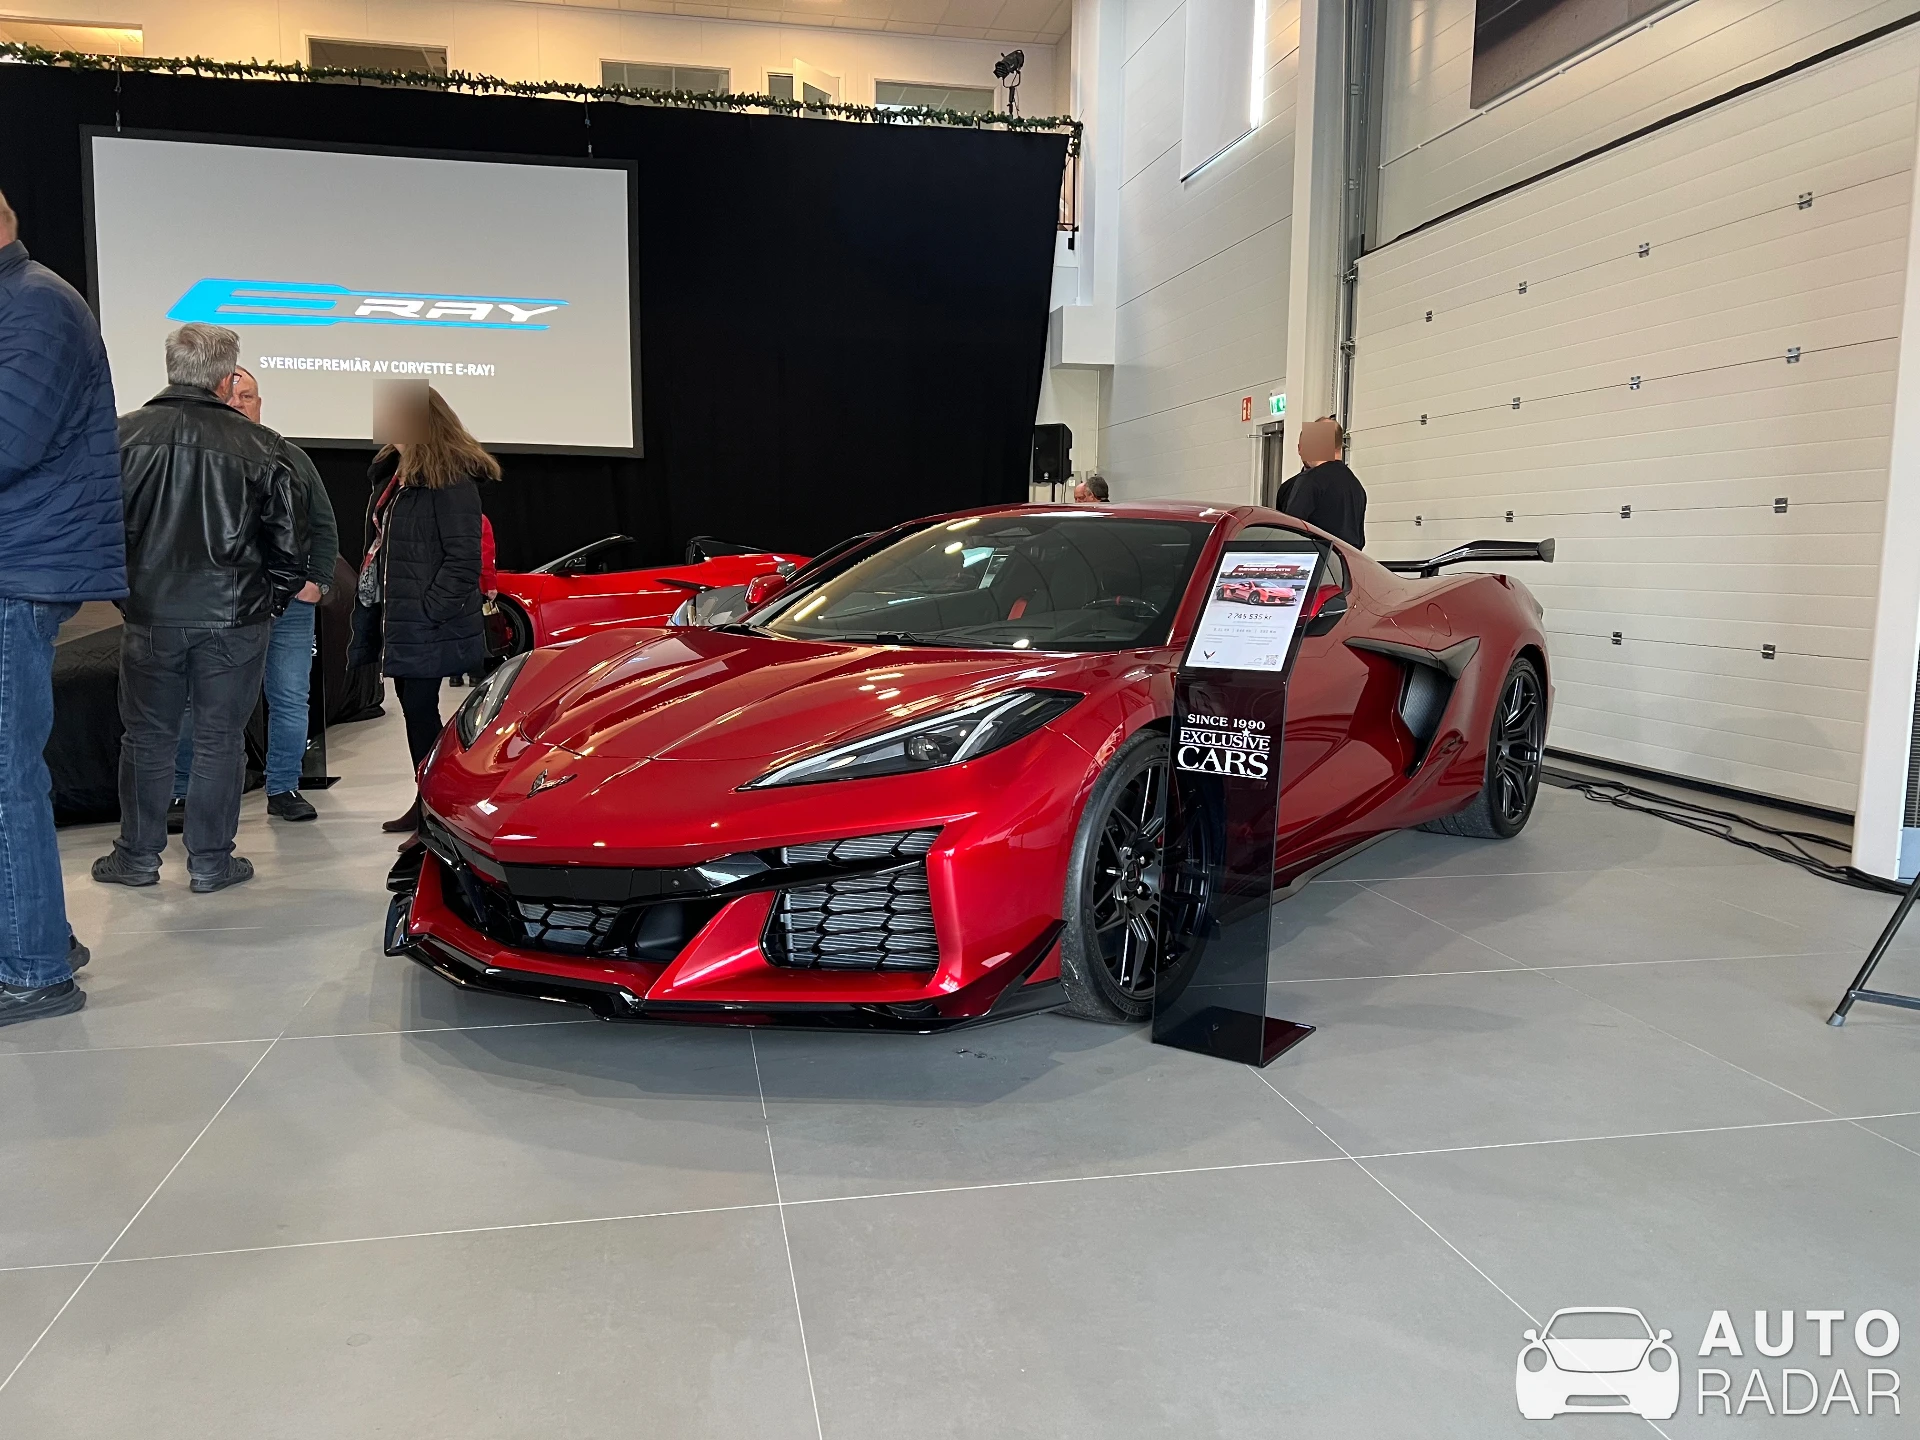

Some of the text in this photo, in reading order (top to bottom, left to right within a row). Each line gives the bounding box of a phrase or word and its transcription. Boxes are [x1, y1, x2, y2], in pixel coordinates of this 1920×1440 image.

[259, 356, 495, 377] SVERIGEPREMIÄR AV CORVETTE E-RAY!
[1187, 713, 1266, 731] SINCE 1990
[1180, 730, 1270, 751] EXCLUSIVE
[1177, 745, 1269, 777] CARS
